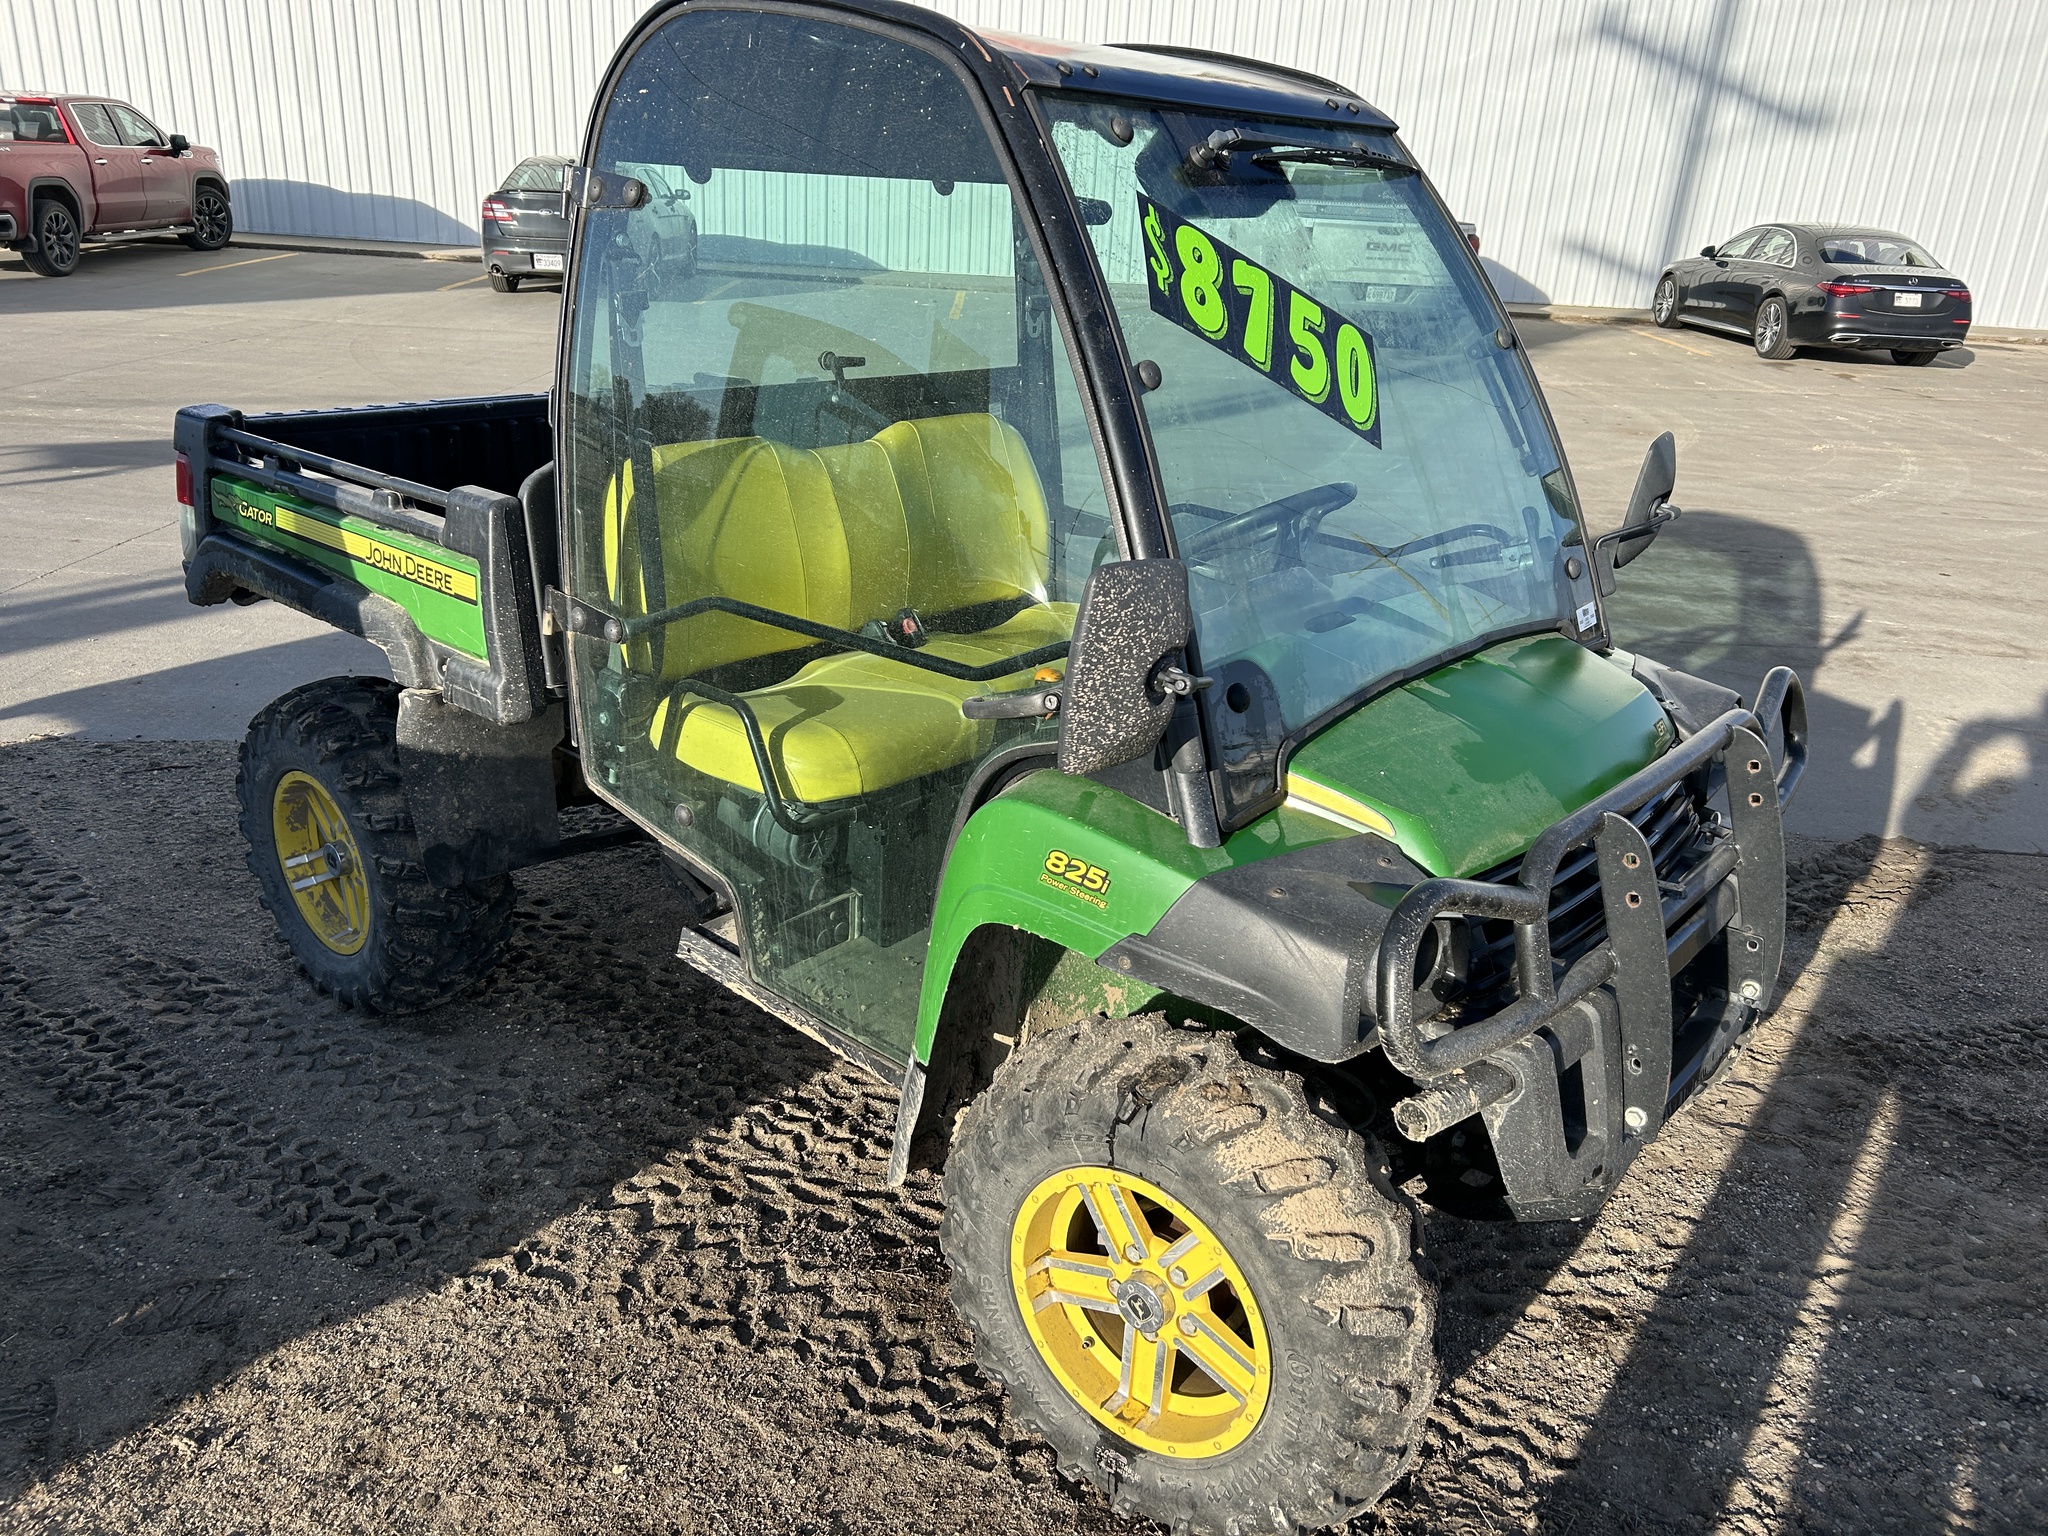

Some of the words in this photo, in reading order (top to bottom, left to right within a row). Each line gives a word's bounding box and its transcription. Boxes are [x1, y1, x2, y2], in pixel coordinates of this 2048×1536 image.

[1366, 242, 1412, 253] GMC
[1144, 203, 1377, 431] $8750
[239, 501, 273, 526] GATOR
[366, 542, 402, 572] JOHN
[405, 555, 453, 591] DEERE
[1040, 873, 1068, 890] Power
[1069, 886, 1108, 909] Steering
[1045, 850, 1111, 895] 825i
